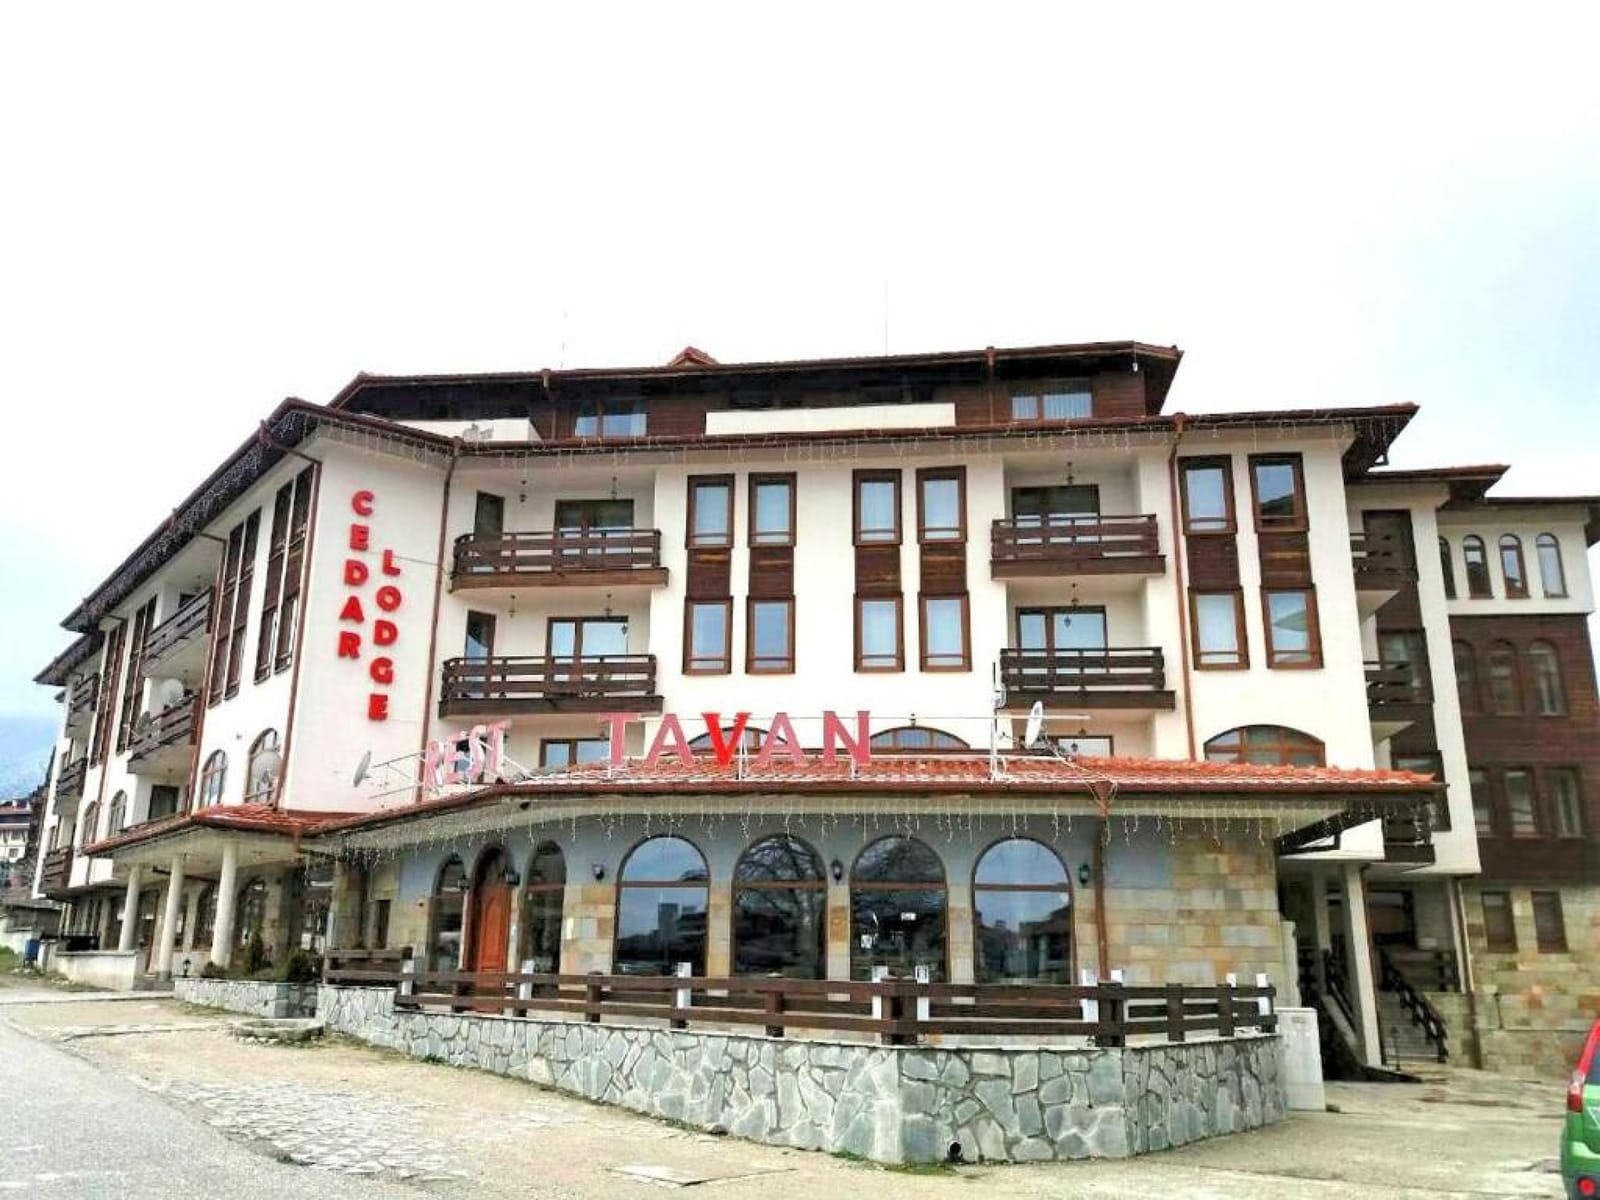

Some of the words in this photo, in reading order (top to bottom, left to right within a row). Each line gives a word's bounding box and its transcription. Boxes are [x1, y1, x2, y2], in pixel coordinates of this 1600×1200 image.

[338, 490, 375, 659] CEDAR
[368, 549, 402, 721] LODGE
[424, 719, 512, 789] REST
[601, 710, 871, 769] TAVAN
